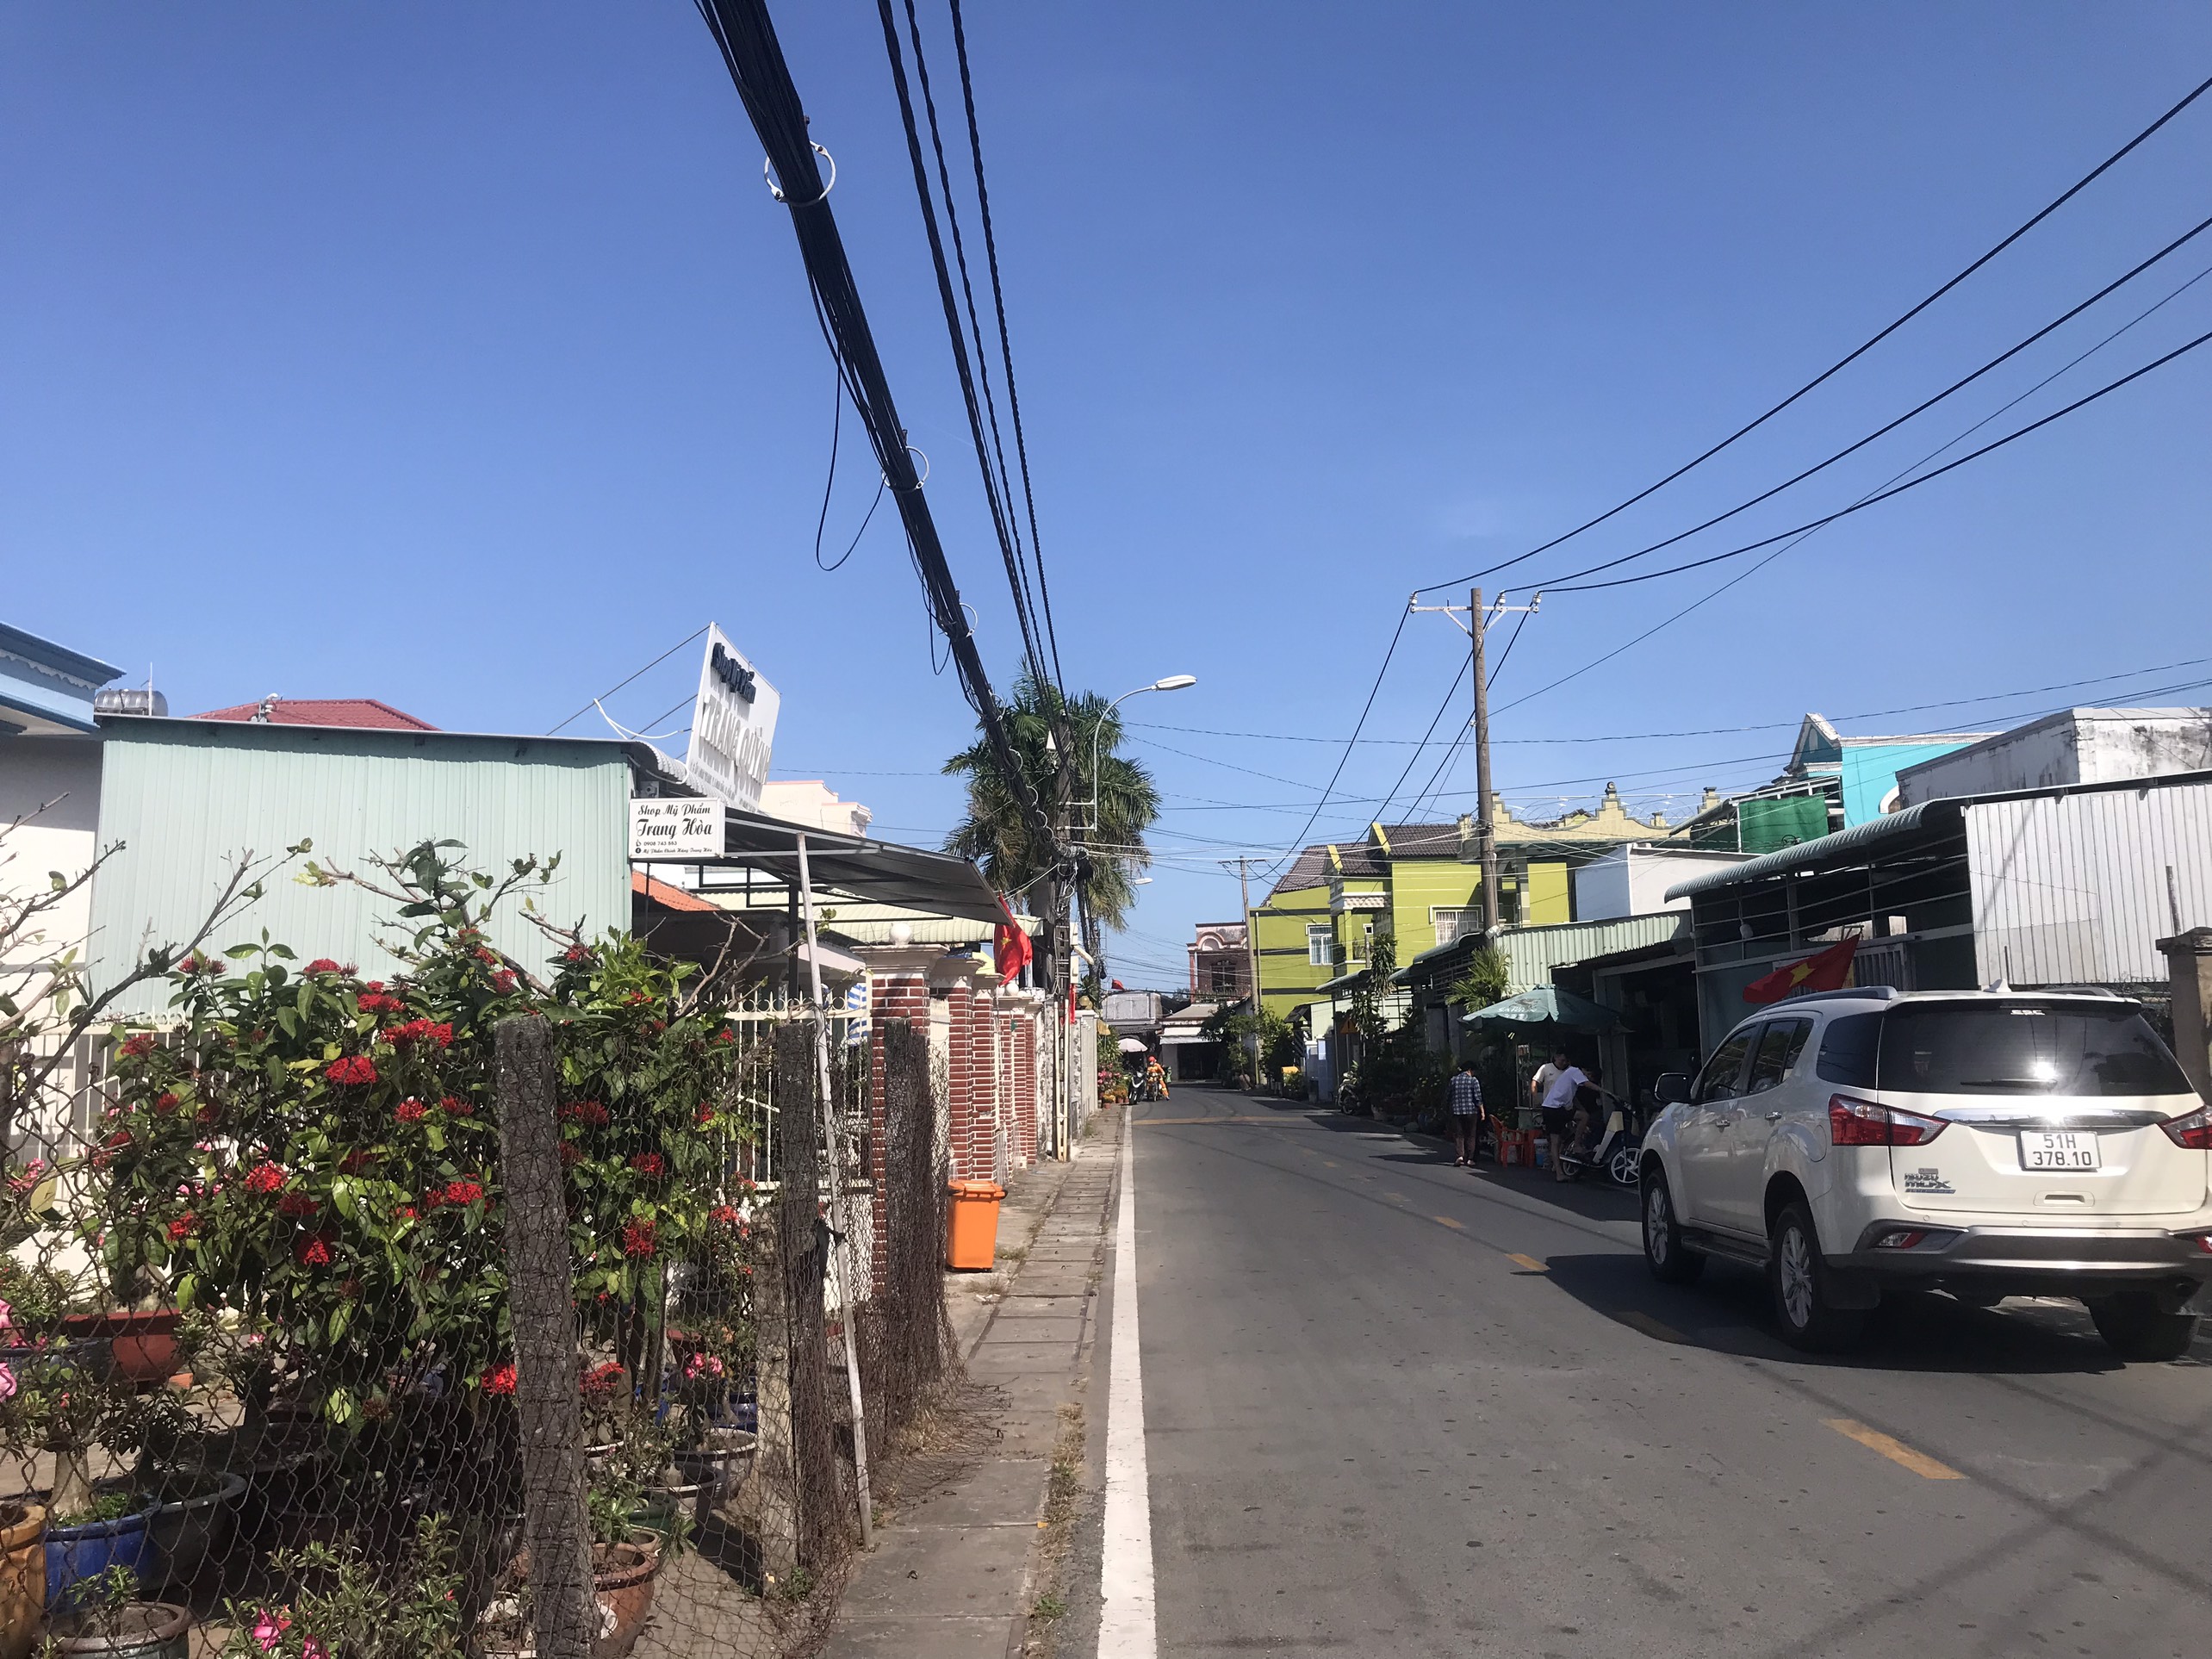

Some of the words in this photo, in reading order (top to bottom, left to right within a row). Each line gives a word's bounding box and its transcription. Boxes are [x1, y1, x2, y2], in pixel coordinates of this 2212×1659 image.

[700, 693, 742, 761] TRANG
[638, 805, 661, 817] Shop
[662, 805, 679, 817] Mỹ
[681, 803, 711, 816] Phẩm
[637, 818, 677, 839] Trang
[682, 818, 713, 836] Hòa
[2043, 1134, 2077, 1149] 51H
[2033, 1151, 2092, 1166] 378.10
